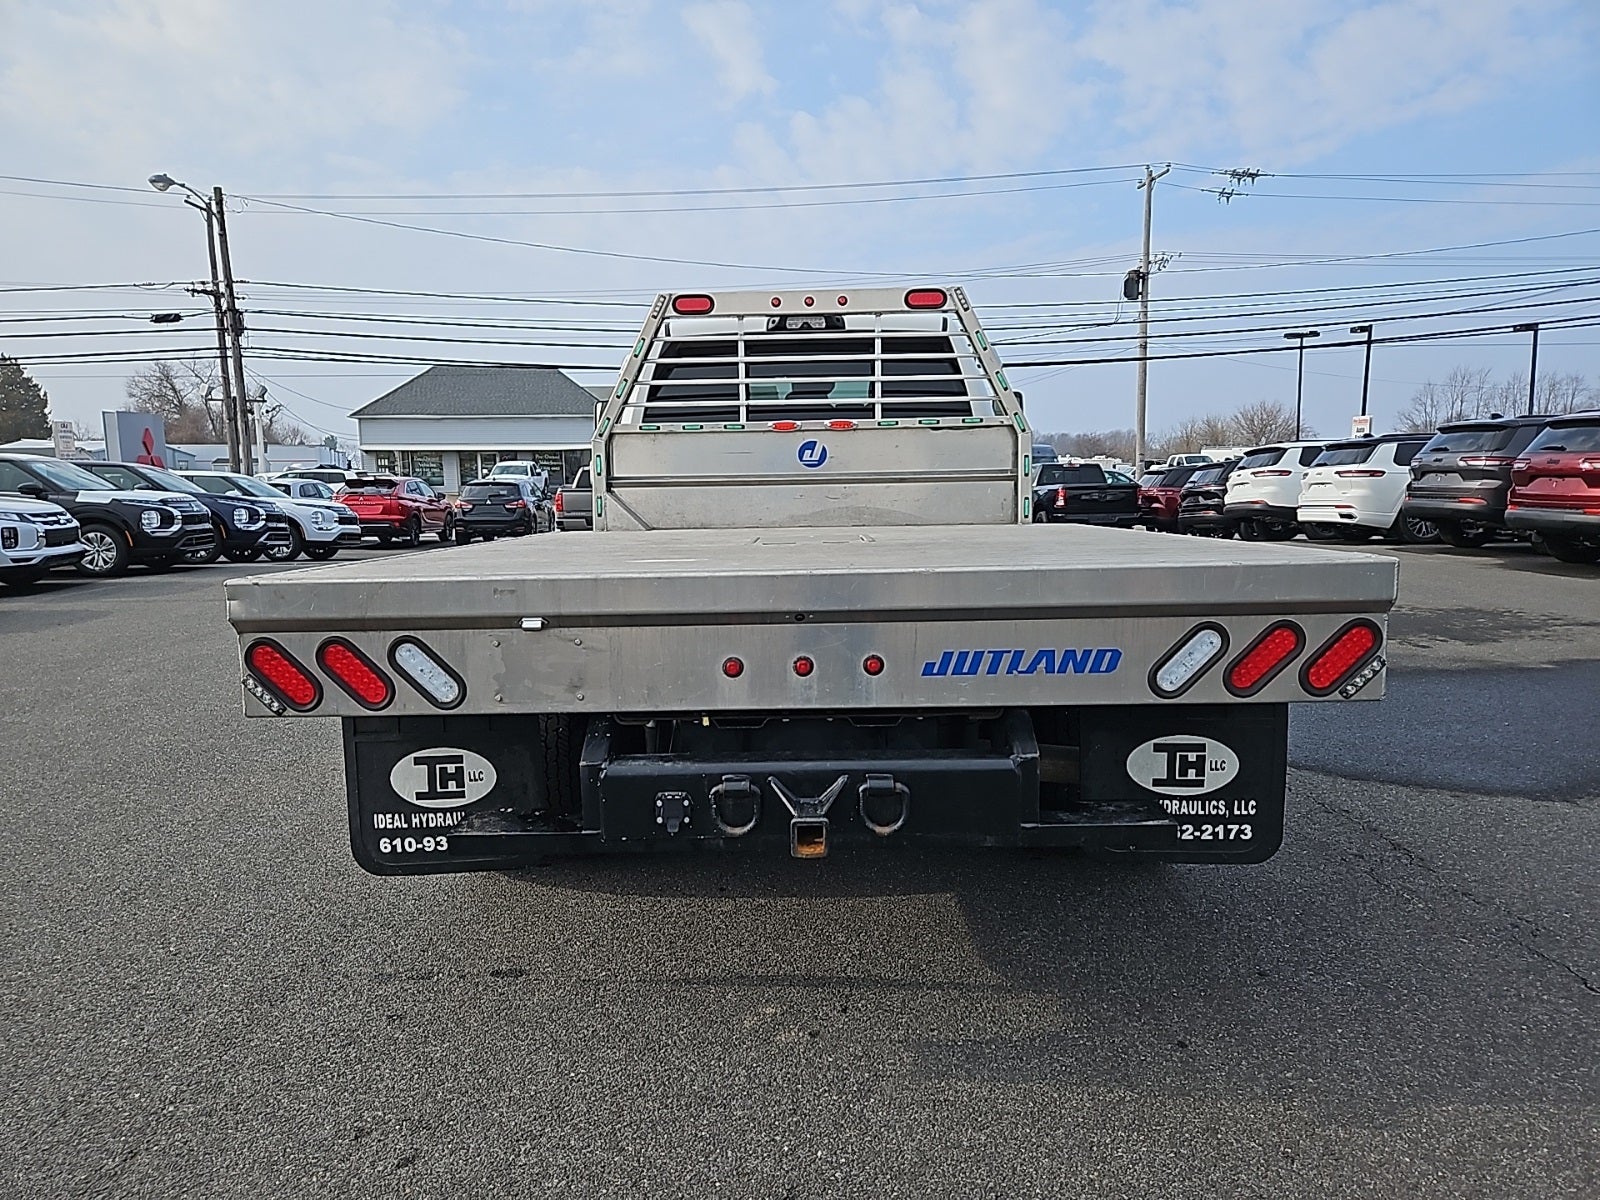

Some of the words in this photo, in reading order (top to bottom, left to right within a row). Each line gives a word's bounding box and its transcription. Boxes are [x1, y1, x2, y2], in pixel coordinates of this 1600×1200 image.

[921, 648, 1123, 677] JUTLAND
[1209, 759, 1226, 772] LLC
[468, 770, 484, 782] LLC
[1159, 800, 1229, 818] DRAULICS,
[1233, 800, 1257, 815] LLC
[373, 813, 408, 829] IDEAL
[411, 811, 465, 828] HYDRAU
[1177, 824, 1253, 840] 2-2173
[379, 836, 448, 853] 610-93
